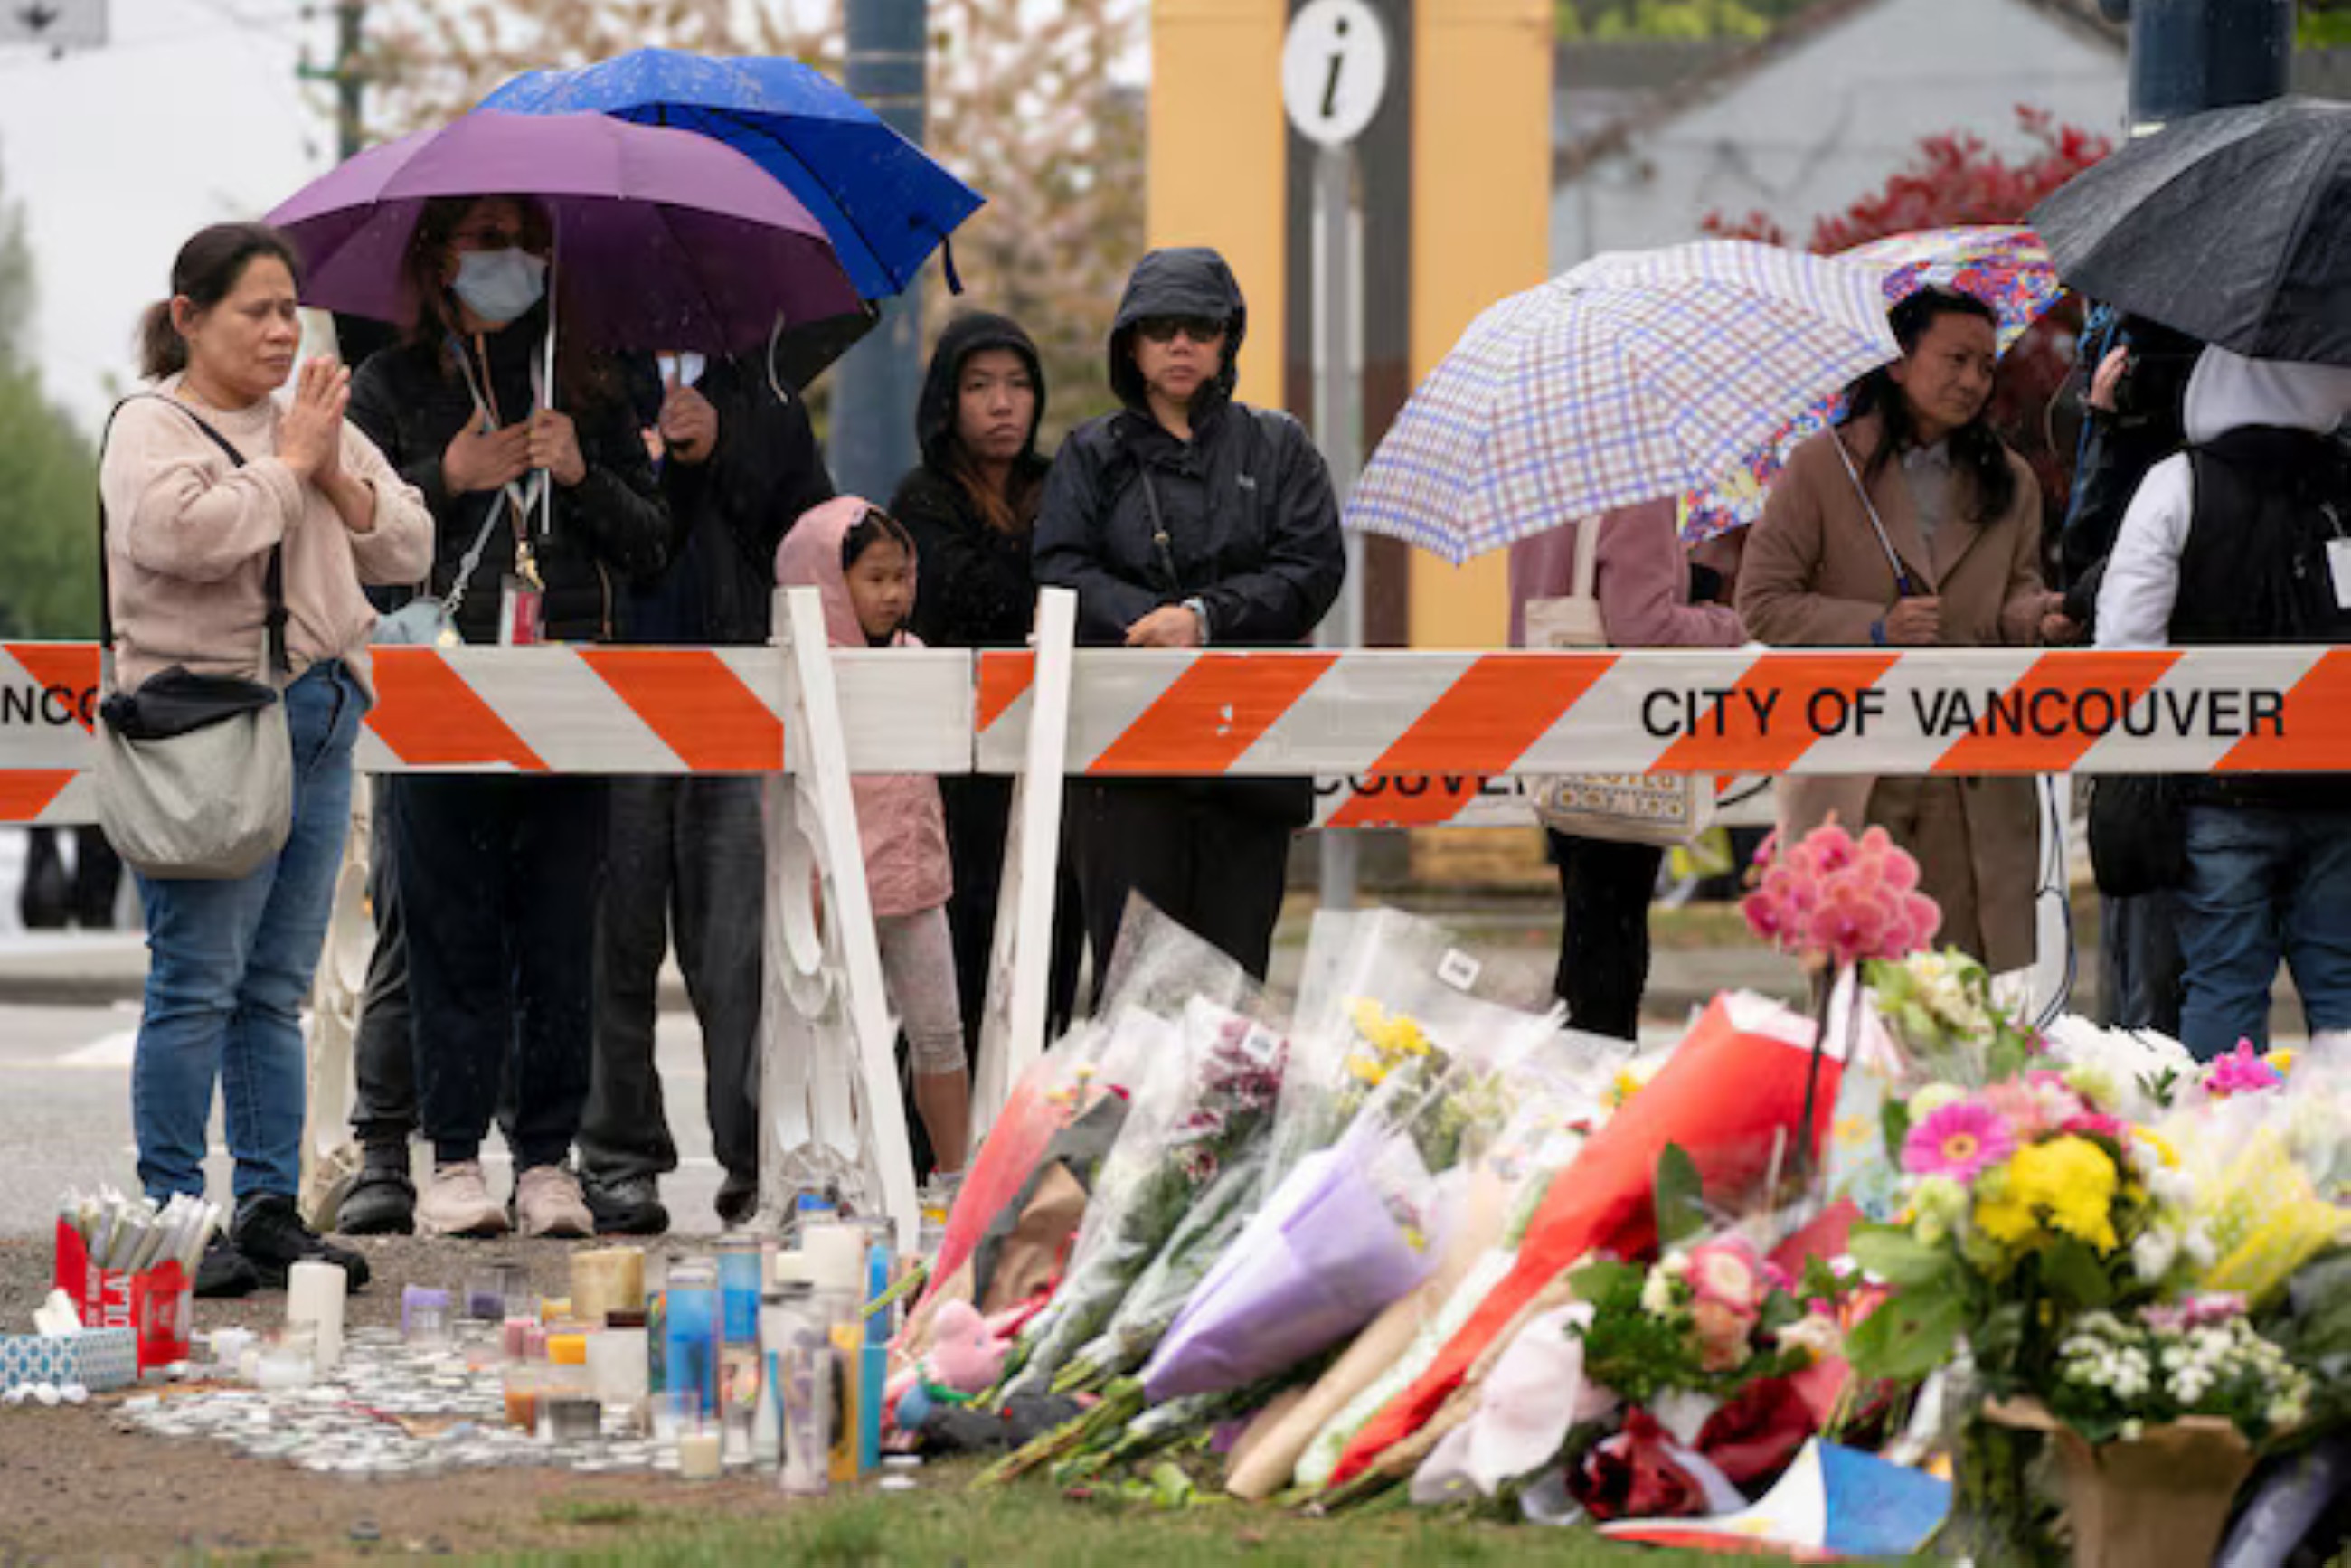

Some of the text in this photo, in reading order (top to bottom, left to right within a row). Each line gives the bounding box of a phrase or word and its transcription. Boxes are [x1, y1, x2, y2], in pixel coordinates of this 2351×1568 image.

[1320, 17, 1349, 118] i
[1642, 688, 2285, 737] CITY OF VANCOUVER
